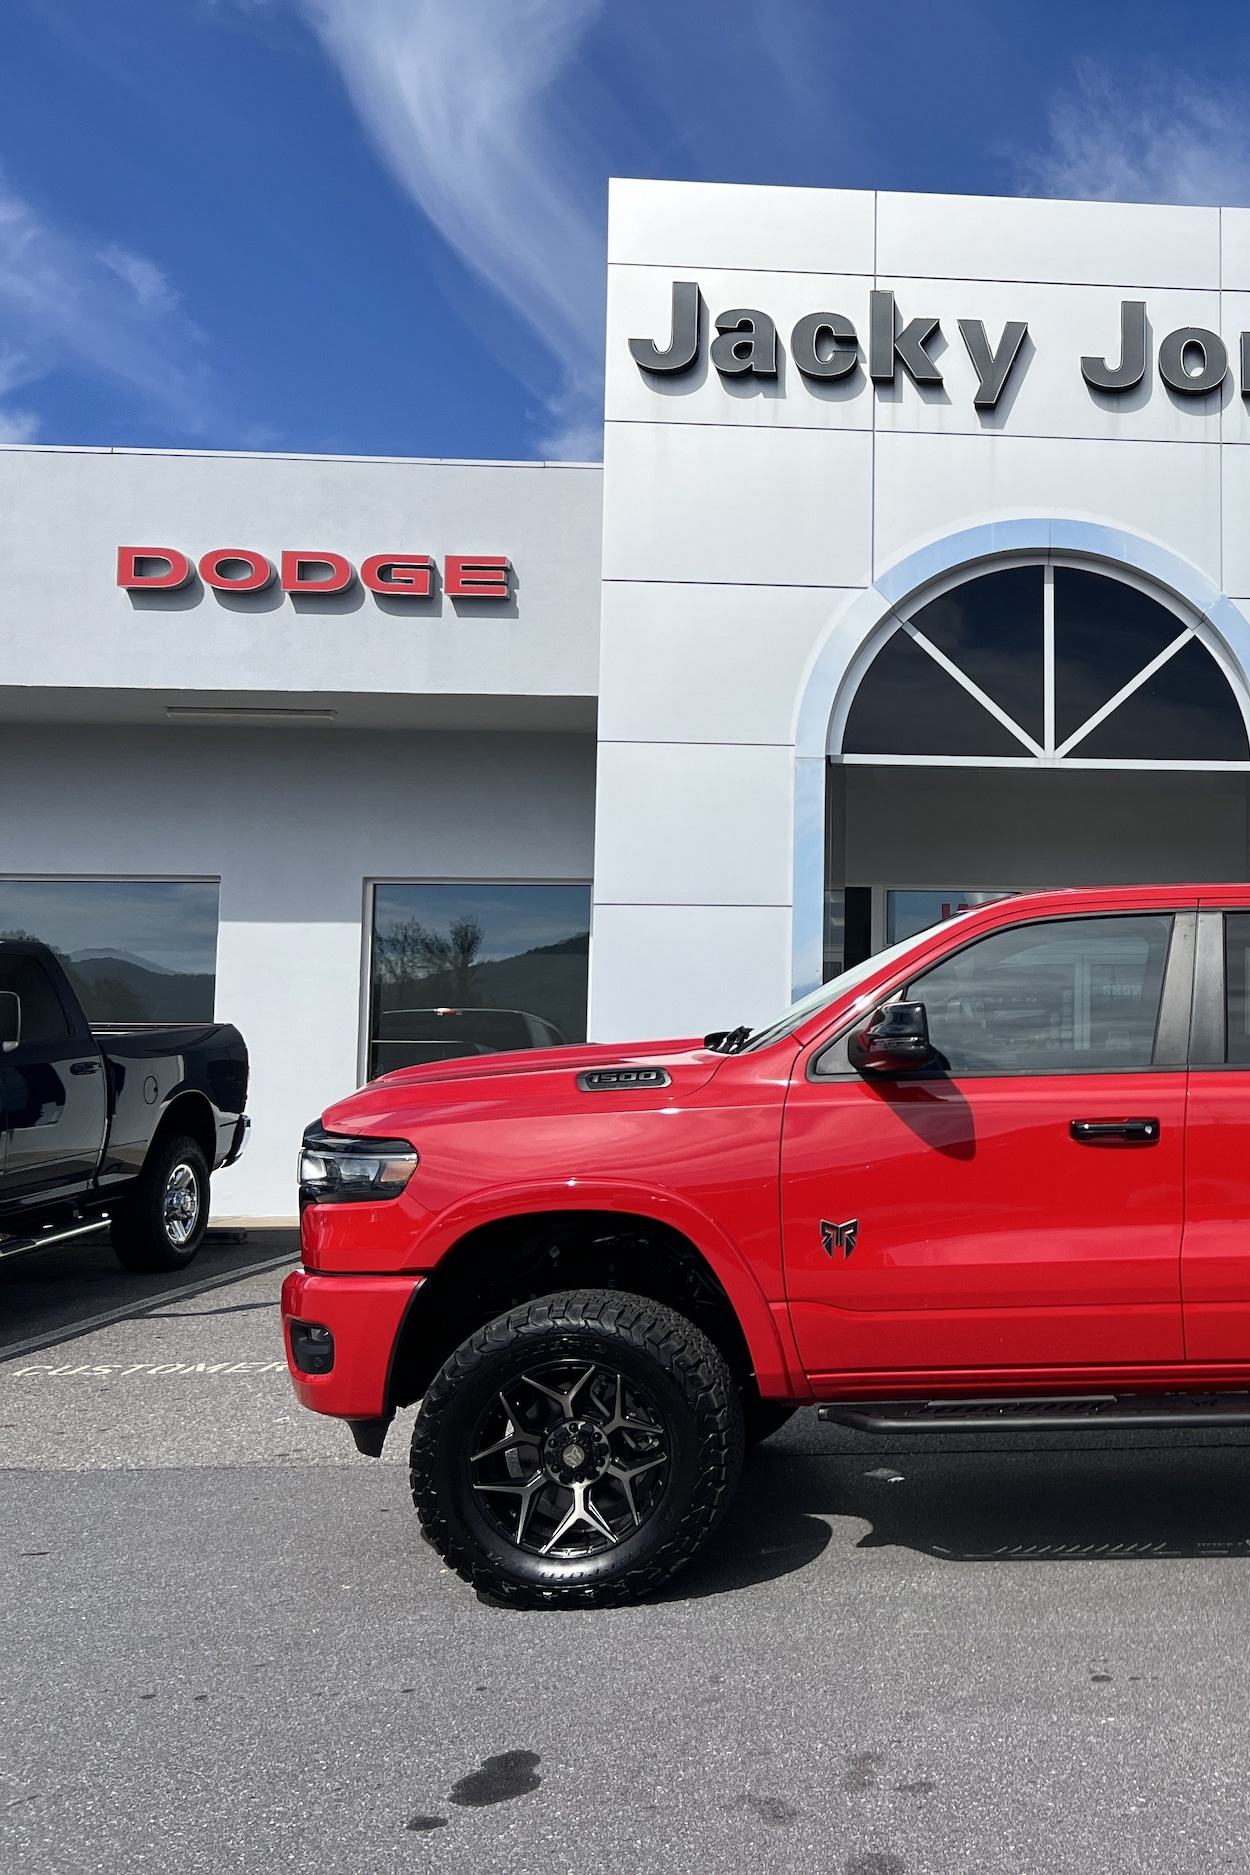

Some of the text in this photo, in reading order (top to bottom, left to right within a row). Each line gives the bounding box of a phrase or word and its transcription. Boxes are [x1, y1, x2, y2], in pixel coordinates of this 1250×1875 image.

[628, 281, 1028, 409] Jacky
[116, 545, 513, 602] DODGE
[590, 1071, 657, 1083] 1500
